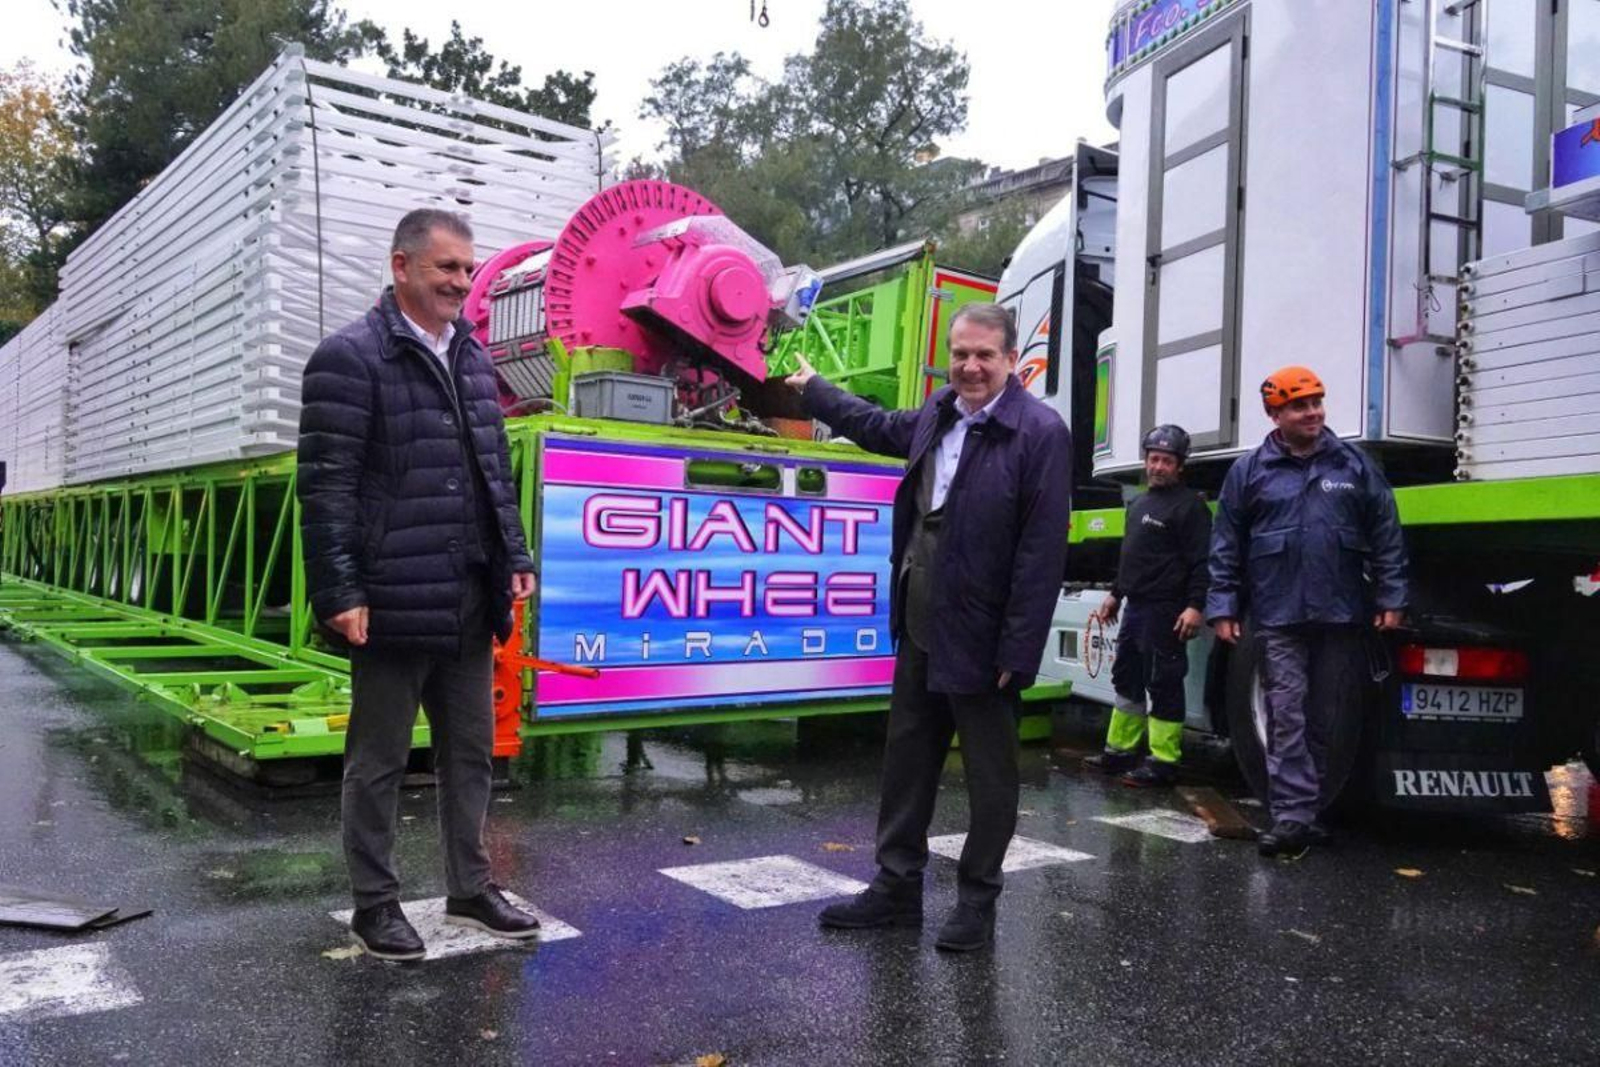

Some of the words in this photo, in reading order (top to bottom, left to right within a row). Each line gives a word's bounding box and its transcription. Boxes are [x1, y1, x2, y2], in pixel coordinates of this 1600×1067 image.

[582, 493, 879, 555] GIANT
[620, 568, 877, 619] WHEE
[574, 628, 878, 662] MiRADO
[1416, 688, 1471, 712] 9412
[1478, 691, 1517, 713] HZP
[1393, 769, 1534, 797] RENAULT
